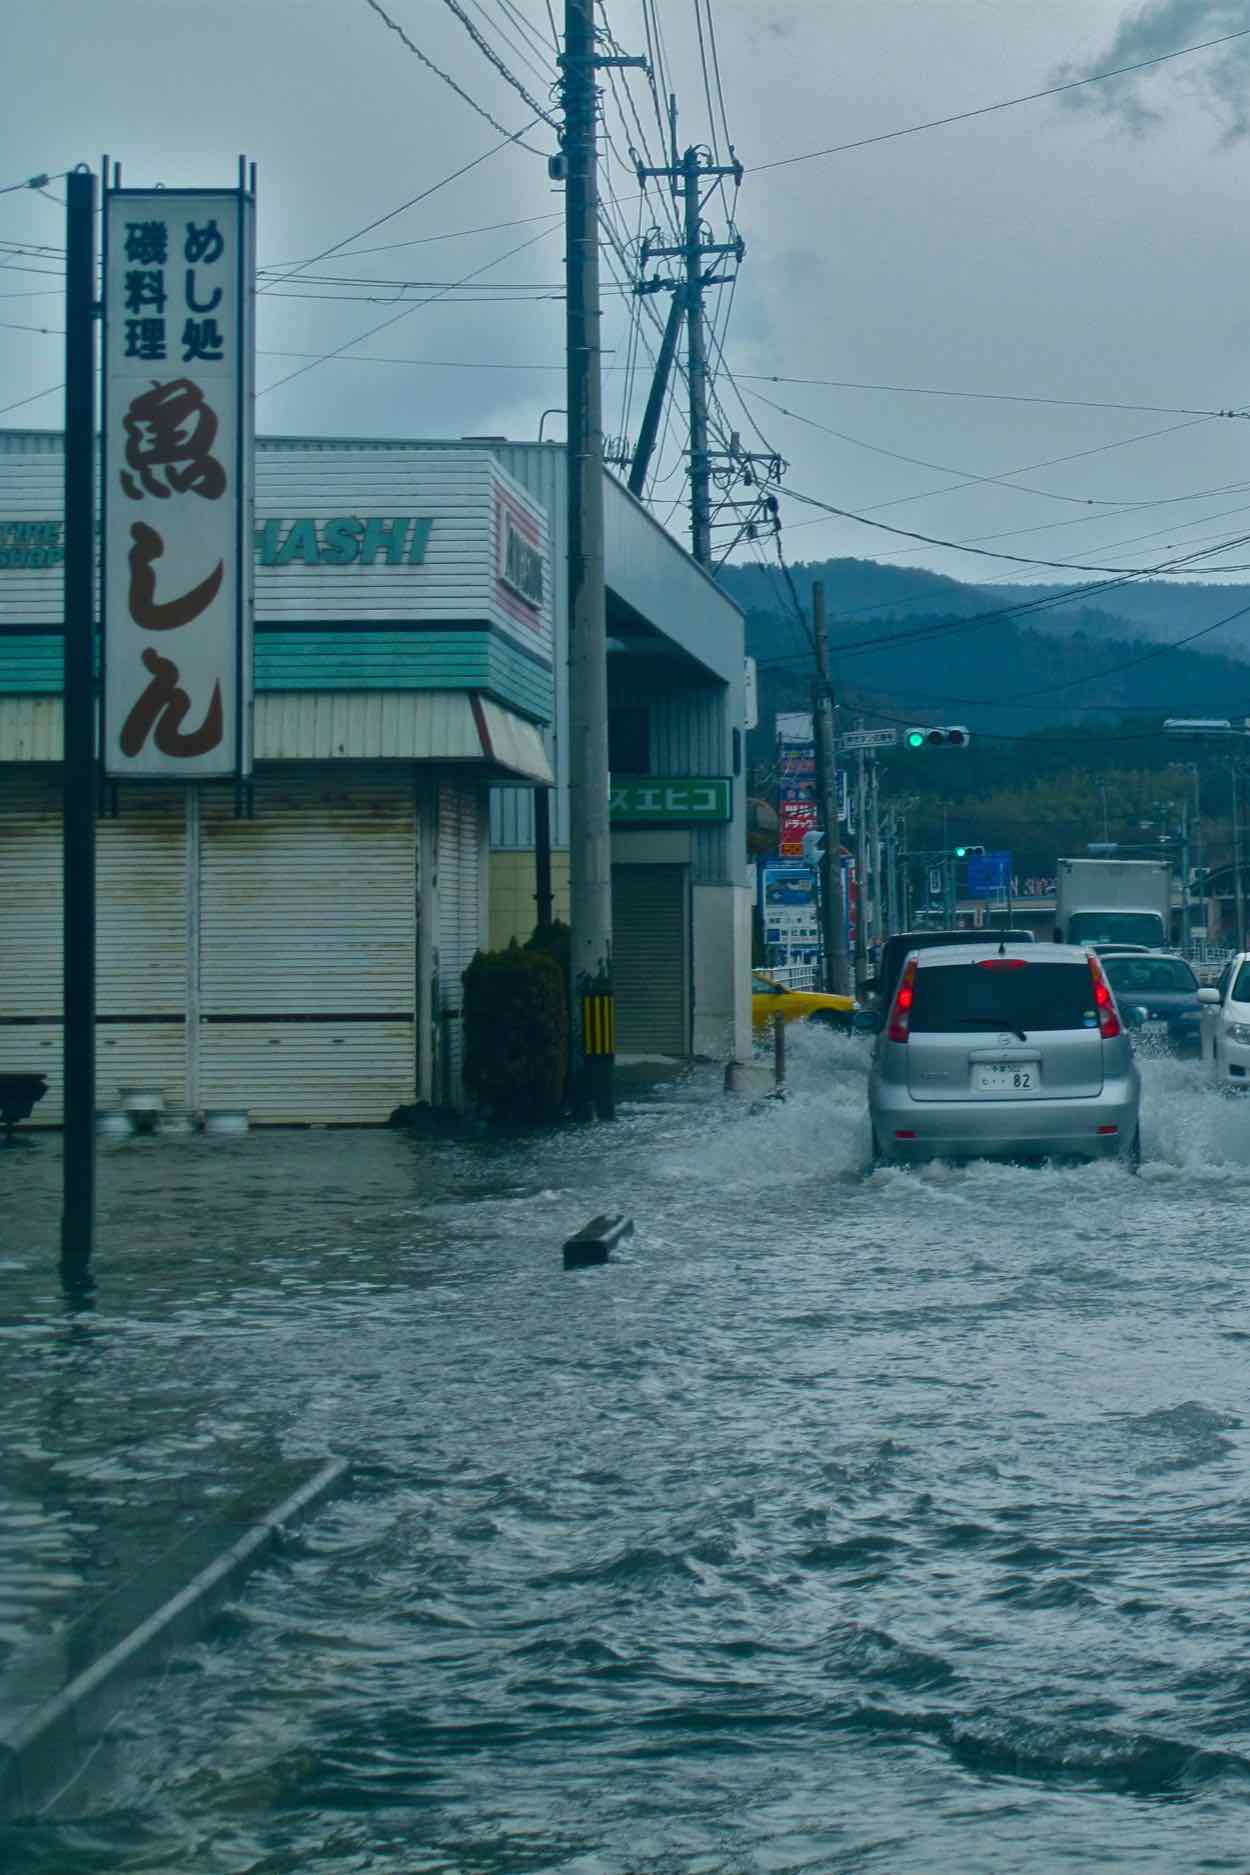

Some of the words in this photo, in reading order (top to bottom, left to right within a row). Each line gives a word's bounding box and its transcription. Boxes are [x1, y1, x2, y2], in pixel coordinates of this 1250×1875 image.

[125, 221, 167, 360] 磯料理
[182, 220, 223, 361] めし処
[119, 378, 227, 758] 魚しん
